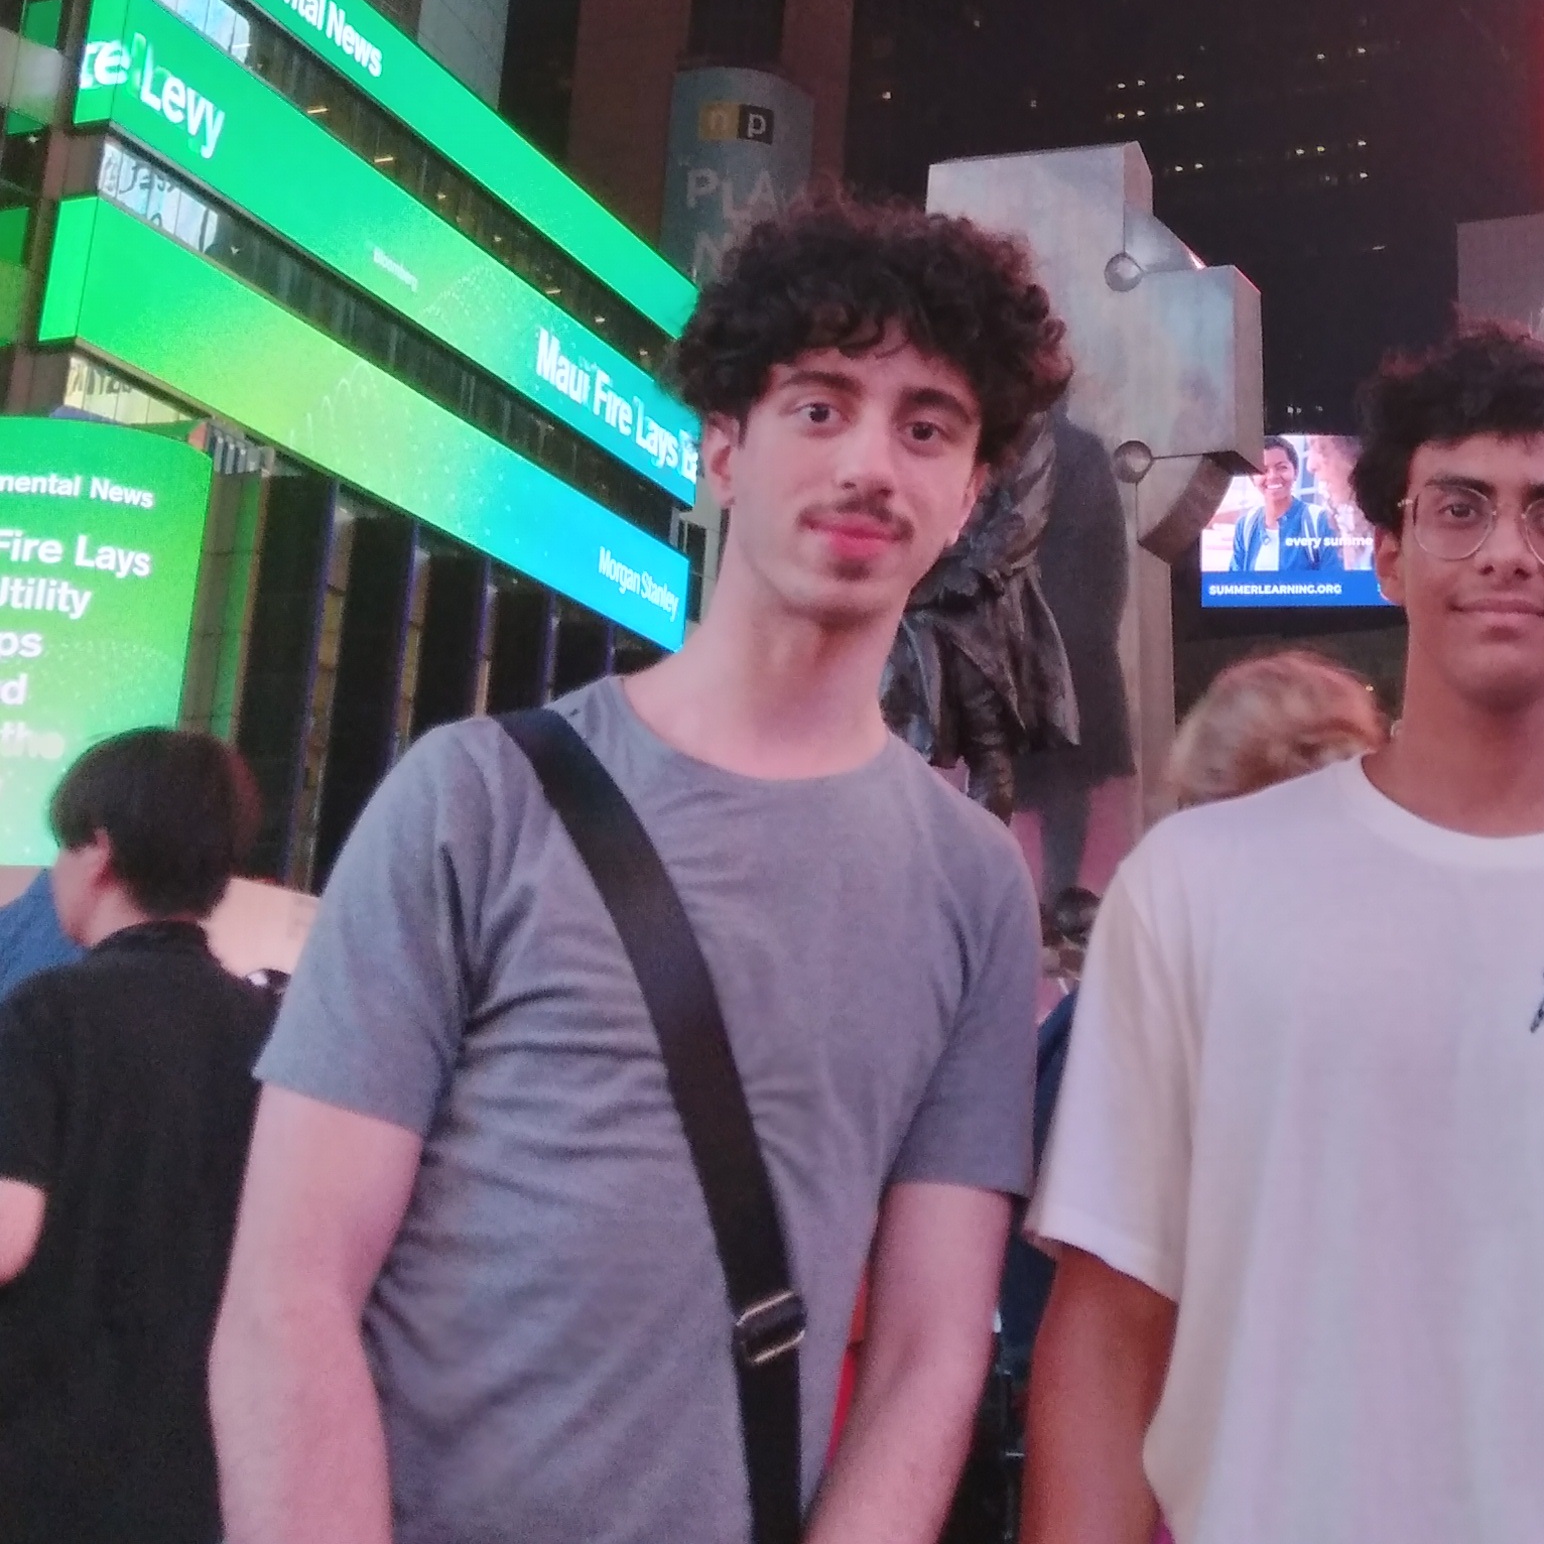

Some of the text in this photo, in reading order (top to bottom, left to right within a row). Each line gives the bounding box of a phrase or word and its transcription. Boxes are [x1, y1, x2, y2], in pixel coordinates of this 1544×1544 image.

[325, 0, 383, 78] News
[139, 39, 226, 159] Levy
[592, 369, 633, 436] Fire
[633, 396, 679, 469] Lays
[89, 478, 156, 510] News
[75, 534, 153, 578] Lays
[1285, 536, 1322, 549] every
[598, 545, 680, 623] Morgan Stanley
[1208, 584, 1343, 595] SUMMERLEARNING.ORG
